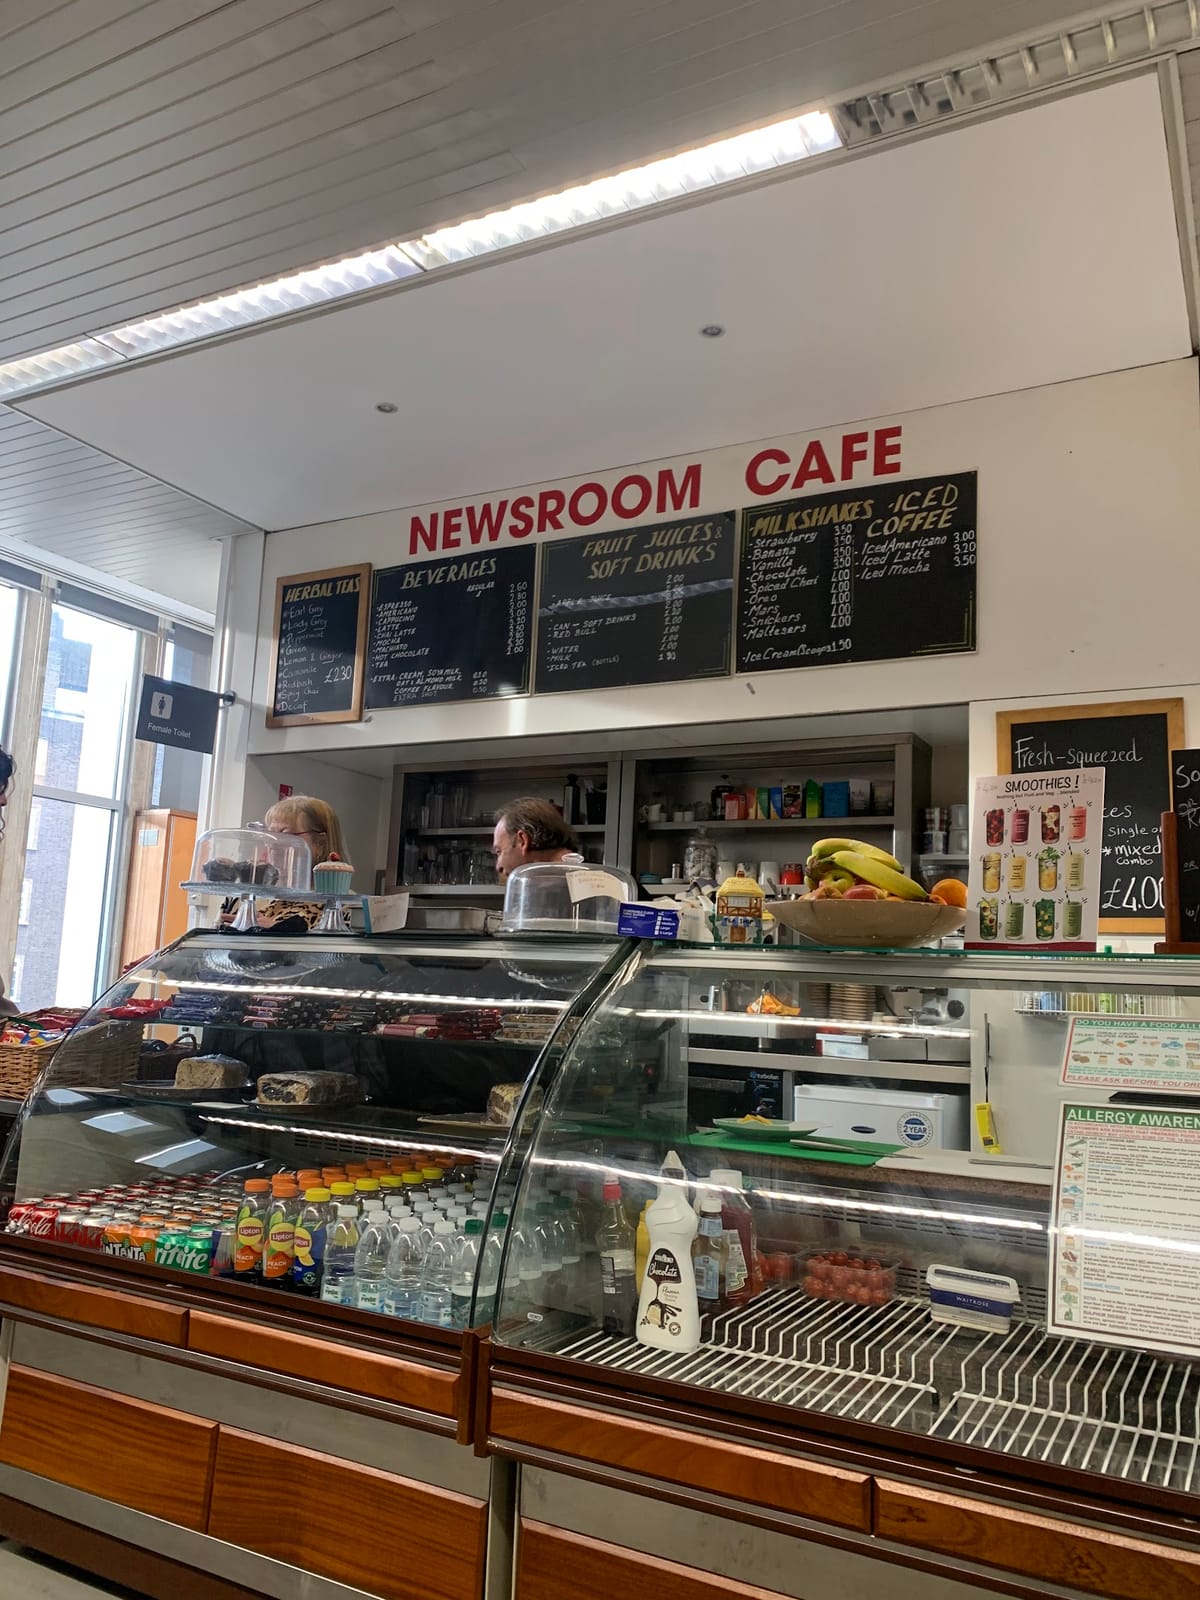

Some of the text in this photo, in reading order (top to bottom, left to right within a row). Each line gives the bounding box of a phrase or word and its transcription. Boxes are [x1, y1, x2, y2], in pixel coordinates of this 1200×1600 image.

[408, 426, 902, 555] NEWSROOM CAFE
[893, 483, 958, 513] ICED
[752, 499, 874, 537] MILKSHAKES
[866, 506, 958, 538] COFFEE
[582, 534, 637, 558] FRUIT
[643, 522, 713, 548] JUICES
[753, 531, 818, 549] Strawberry
[953, 530, 975, 543] 3.00
[752, 546, 796, 560] Banana
[861, 548, 931, 565] Iced Latte
[953, 542, 976, 555] 3.20
[587, 542, 718, 579] SOFT DRINKS
[752, 556, 793, 571] Vanilla
[953, 554, 977, 567] 3.50
[400, 557, 497, 589] BEVERAGES
[861, 561, 930, 580] Iced Mocha
[284, 581, 333, 603] HERBAL
[749, 578, 789, 595] Spiced
[749, 594, 777, 604] Oreo
[748, 605, 780, 616] Mars
[746, 613, 801, 628] Snickers
[746, 624, 806, 640] Maltesers
[148, 722, 191, 739] Female Toilet
[1005, 776, 1071, 793] SMOOTHIES
[1107, 824, 1149, 838] single
[1115, 840, 1161, 856] mixed
[1116, 856, 1154, 866] combo
[1113, 1020, 1140, 1028] HAVE
[1150, 1021, 1178, 1029] FOOD
[1122, 1078, 1159, 1086] BEFORE
[1162, 1079, 1182, 1087] YOU
[1067, 1108, 1136, 1124] ALLERGY
[903, 1125, 909, 1133] 2
[649, 1261, 678, 1277] Chocolate
[956, 1296, 989, 1307] WAITROSE
